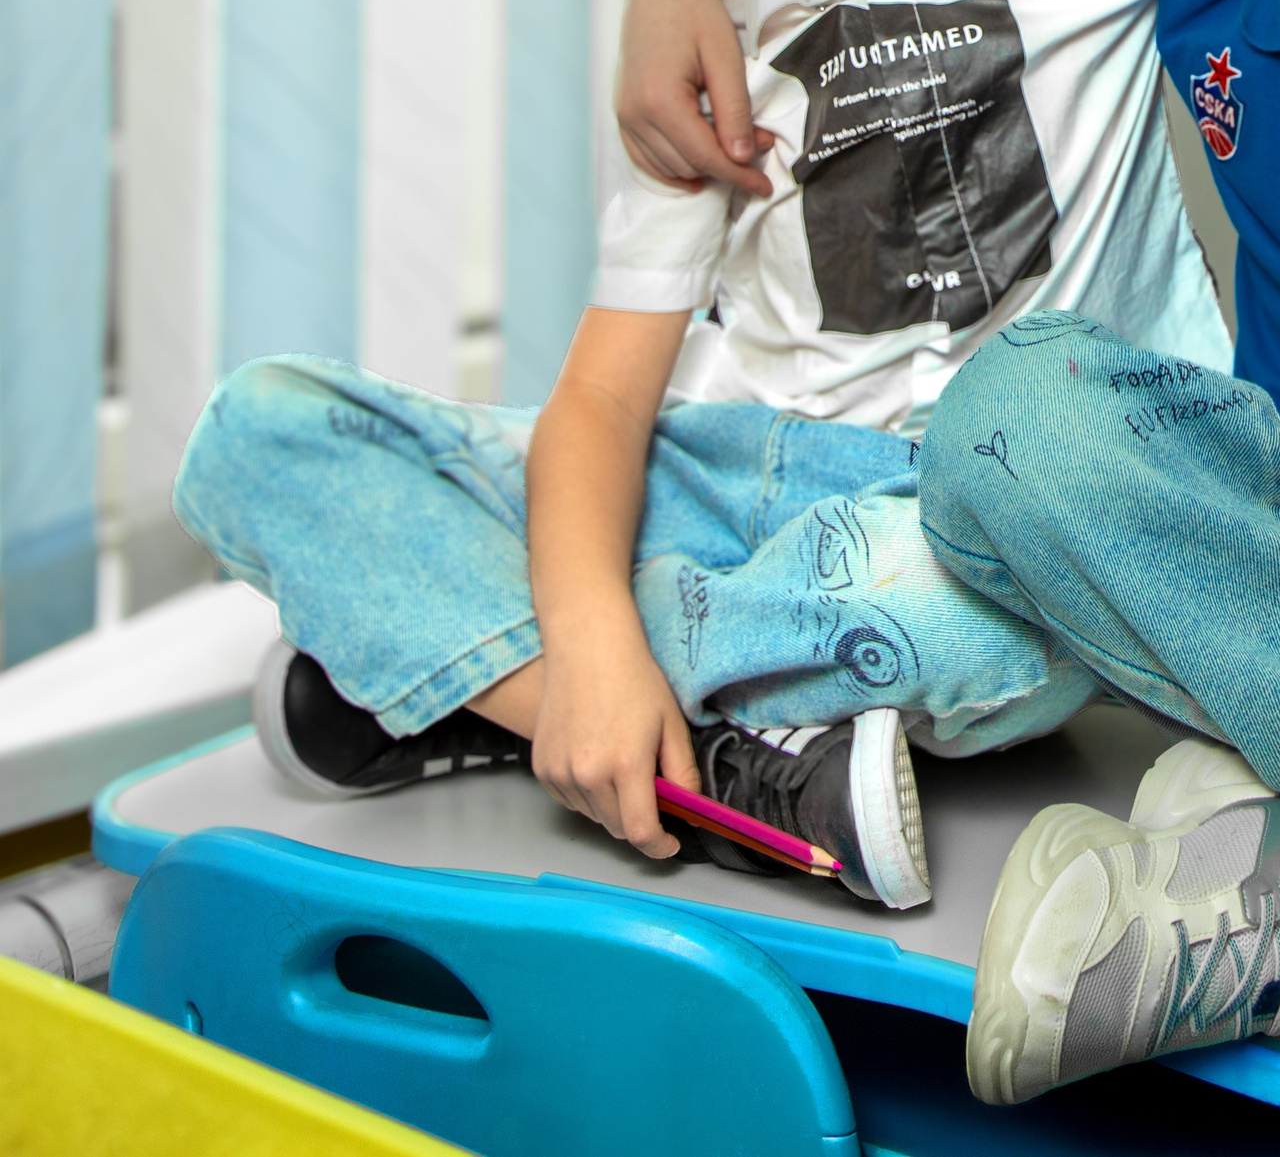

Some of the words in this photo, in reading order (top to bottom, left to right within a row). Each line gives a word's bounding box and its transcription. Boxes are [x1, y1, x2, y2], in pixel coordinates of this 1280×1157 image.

[819, 50, 846, 88] STAY
[849, 24, 984, 69] UNTAMED
[1195, 86, 1236, 129] CSKA
